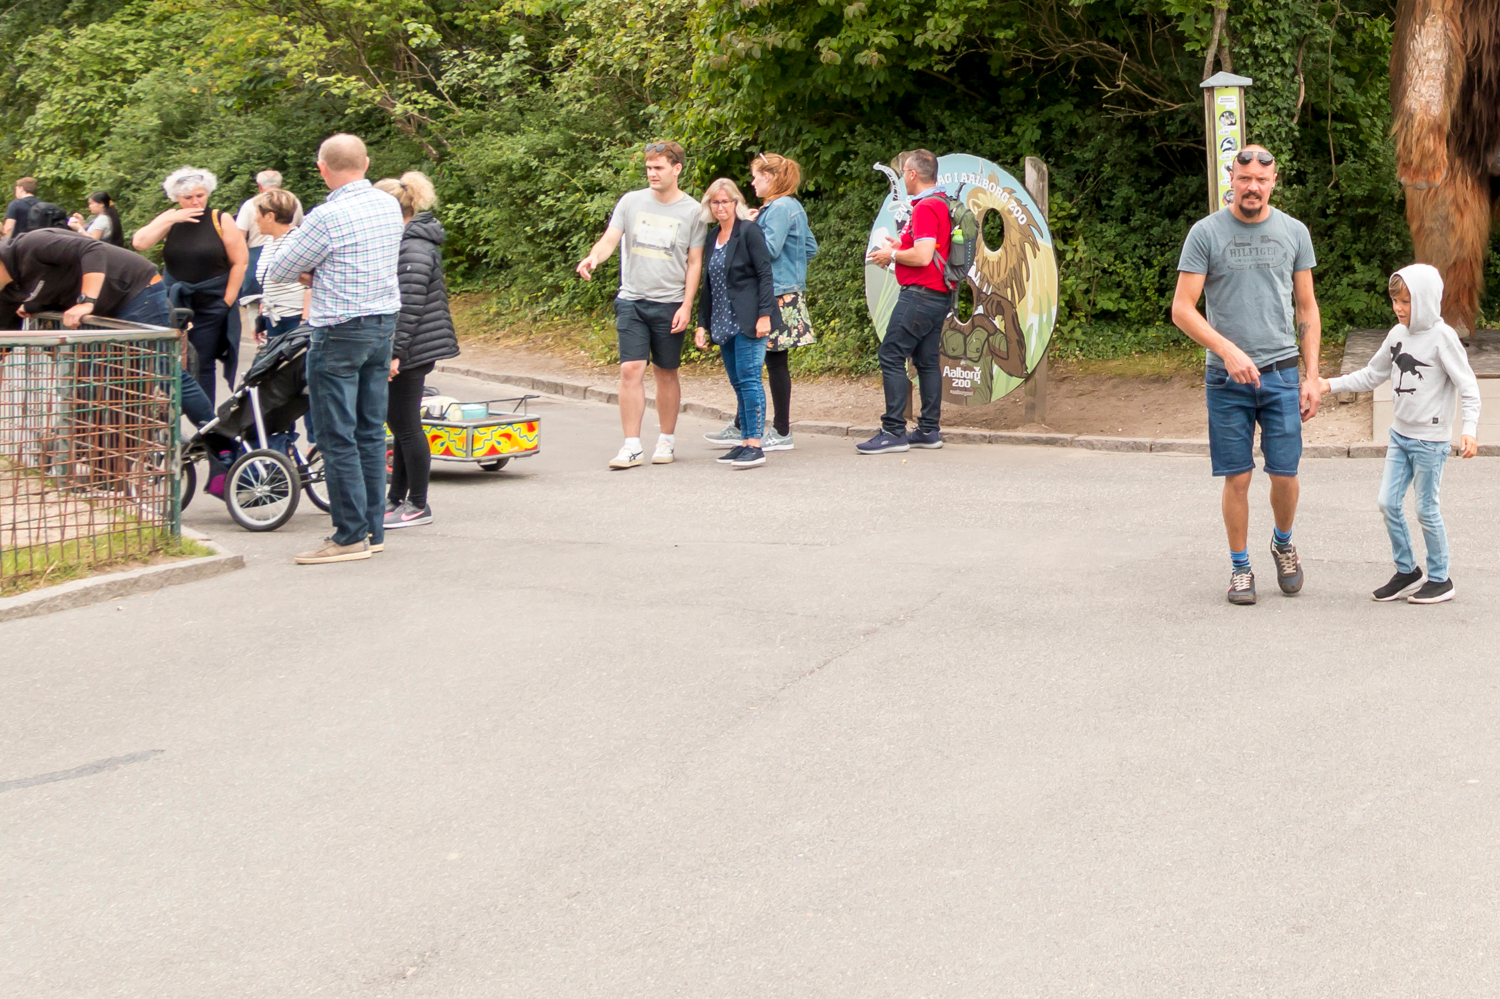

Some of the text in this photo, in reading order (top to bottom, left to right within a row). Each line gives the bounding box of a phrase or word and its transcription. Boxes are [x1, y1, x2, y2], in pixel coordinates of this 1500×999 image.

[935, 172, 952, 186] AG
[961, 172, 1010, 203] AALBORG
[1007, 199, 1028, 226] ZOO
[943, 366, 982, 385] Aalborg
